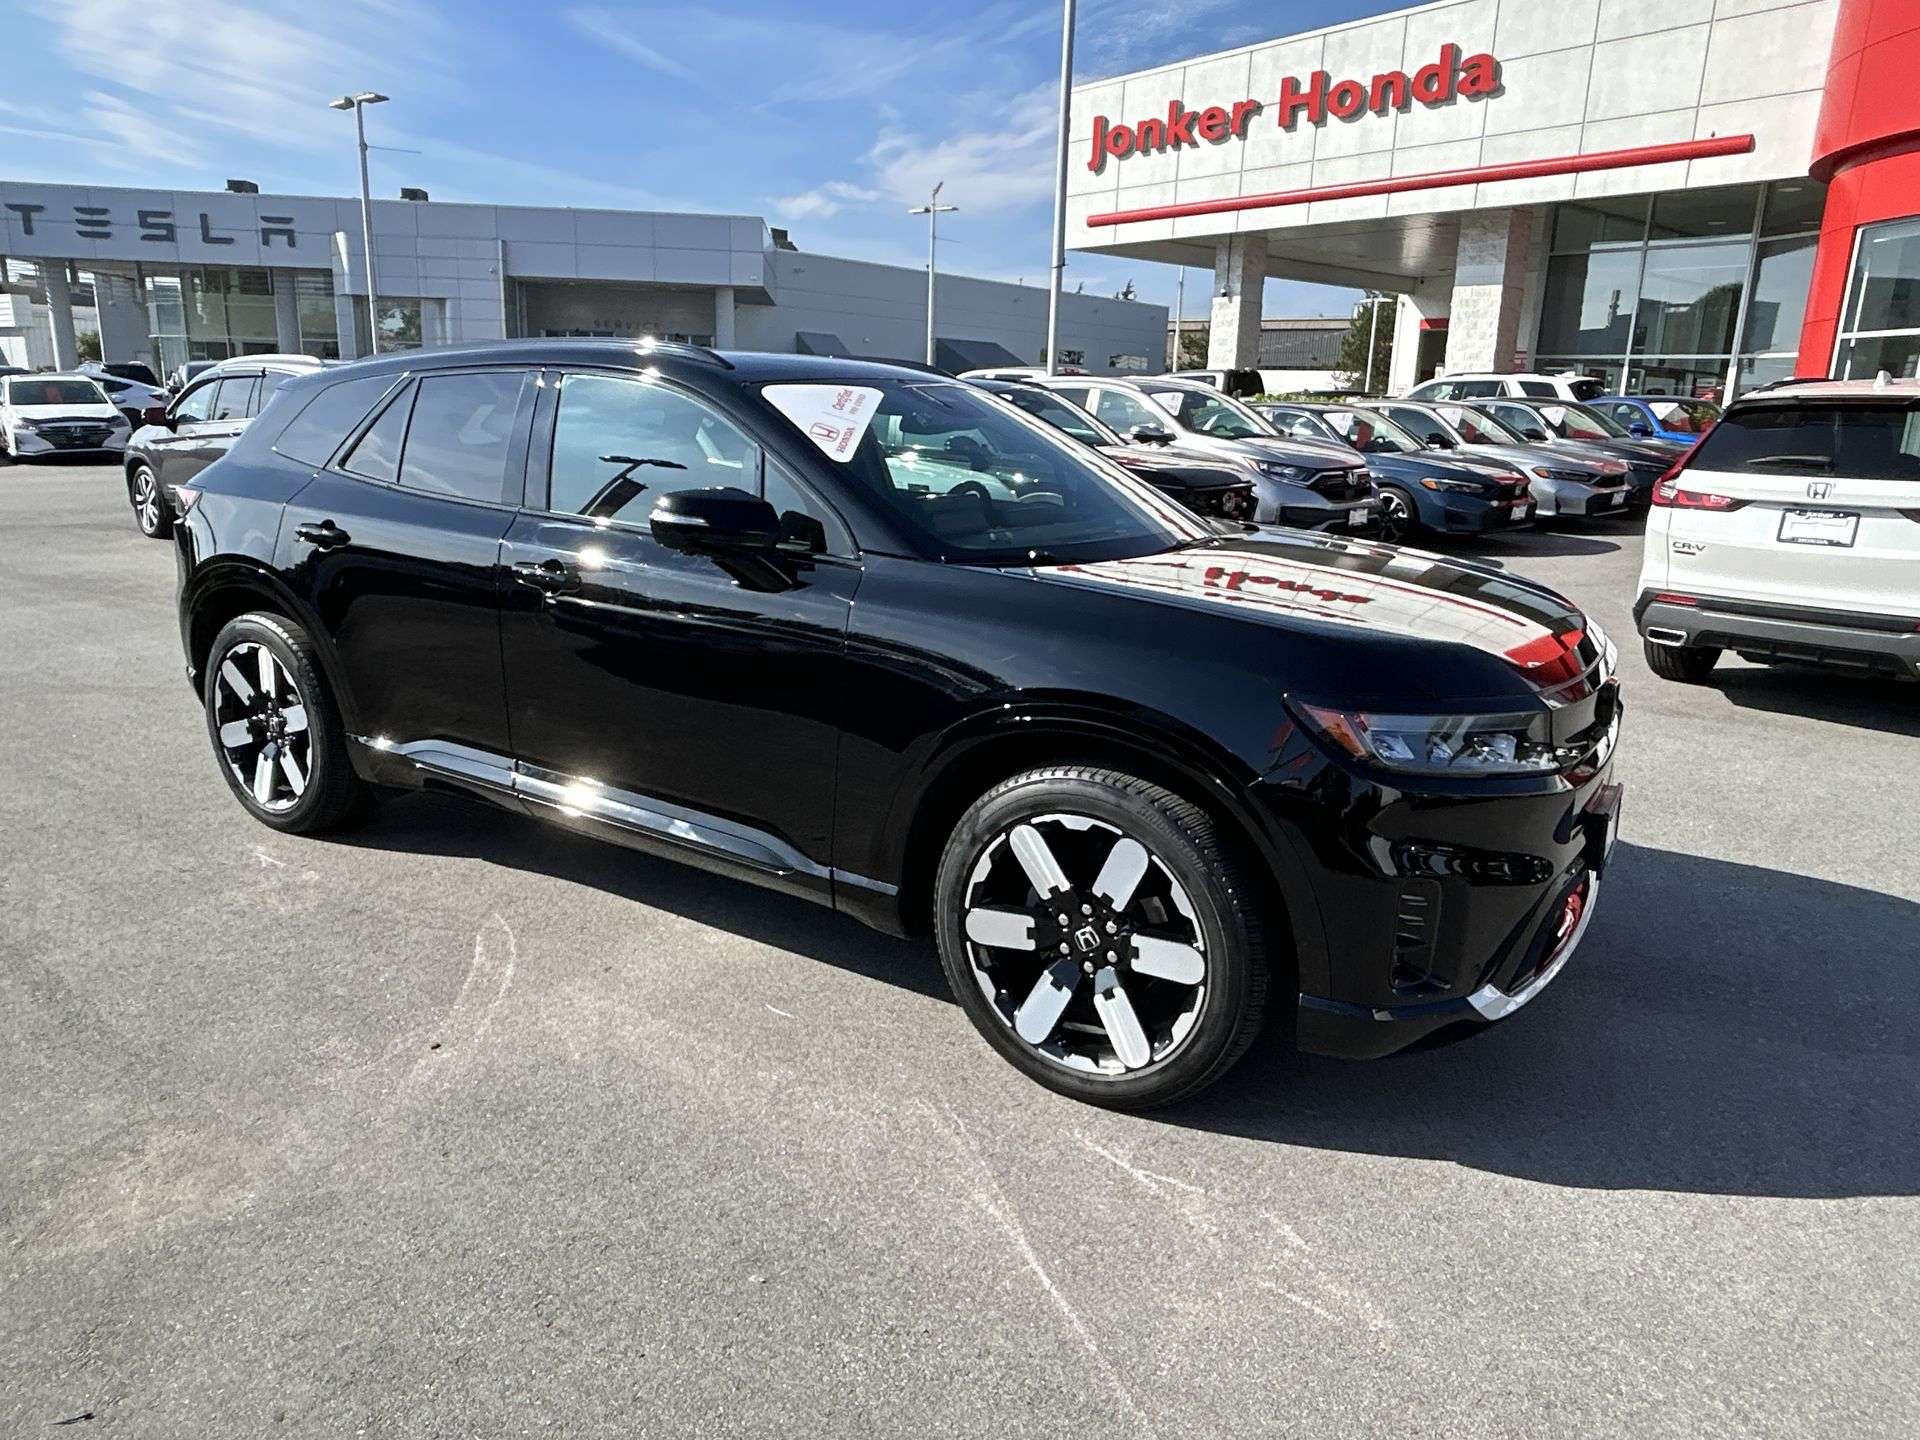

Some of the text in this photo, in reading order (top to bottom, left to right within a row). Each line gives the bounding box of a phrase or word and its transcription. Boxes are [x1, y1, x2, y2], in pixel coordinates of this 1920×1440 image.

[1087, 43, 1503, 174] Jonker Honda
[4, 203, 297, 248] TESLA
[1672, 541, 1706, 551] CR-V
